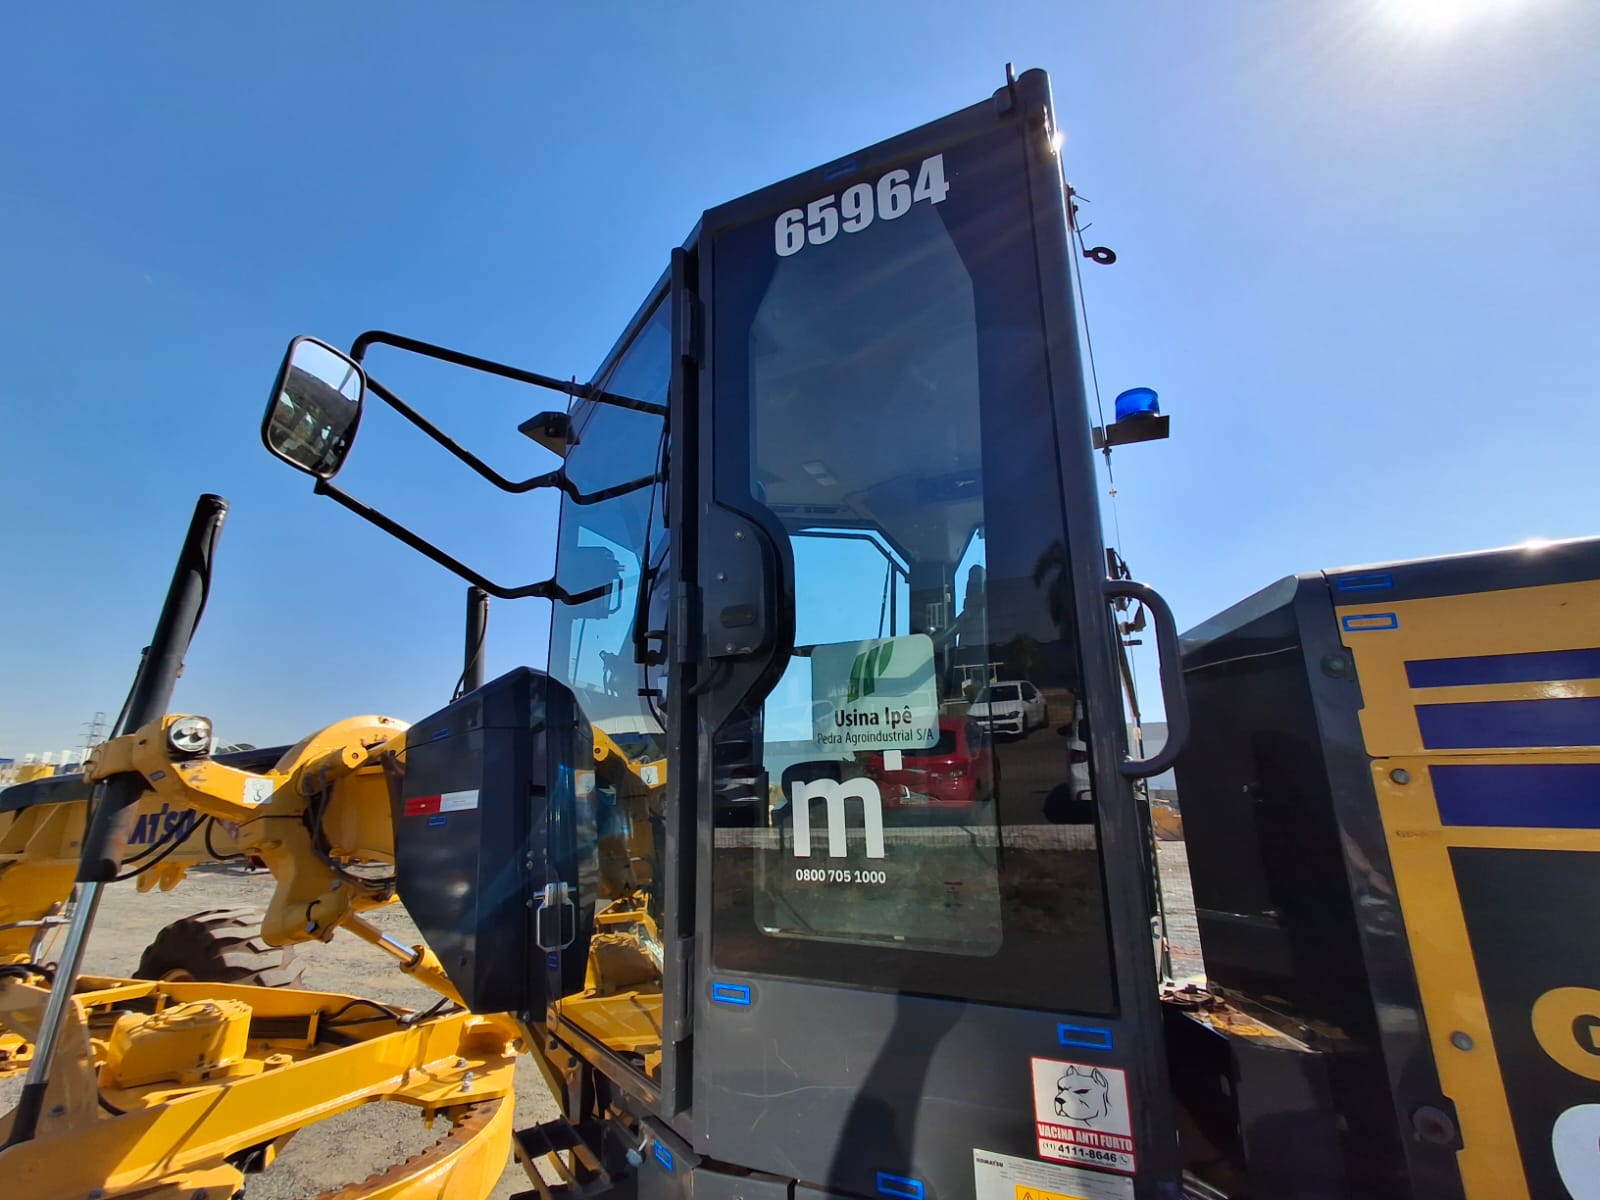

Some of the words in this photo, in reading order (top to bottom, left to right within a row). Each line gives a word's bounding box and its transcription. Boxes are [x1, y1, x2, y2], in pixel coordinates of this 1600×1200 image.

[774, 153, 950, 258] 65964
[834, 709, 879, 727] Usina
[885, 705, 913, 729] Ipê
[817, 732, 843, 745] Pedra
[845, 730, 913, 746] Agroindustrial
[916, 729, 934, 742] S/A
[795, 868, 826, 881] 0800
[828, 869, 852, 883] 705
[854, 870, 887, 884] 1000
[1037, 1123, 1075, 1142] VACINA
[1076, 1128, 1099, 1146] ANTI
[1100, 1134, 1133, 1152] FURTO
[1042, 1141, 1056, 1151] (11)
[1058, 1142, 1118, 1163] 4111-8646
